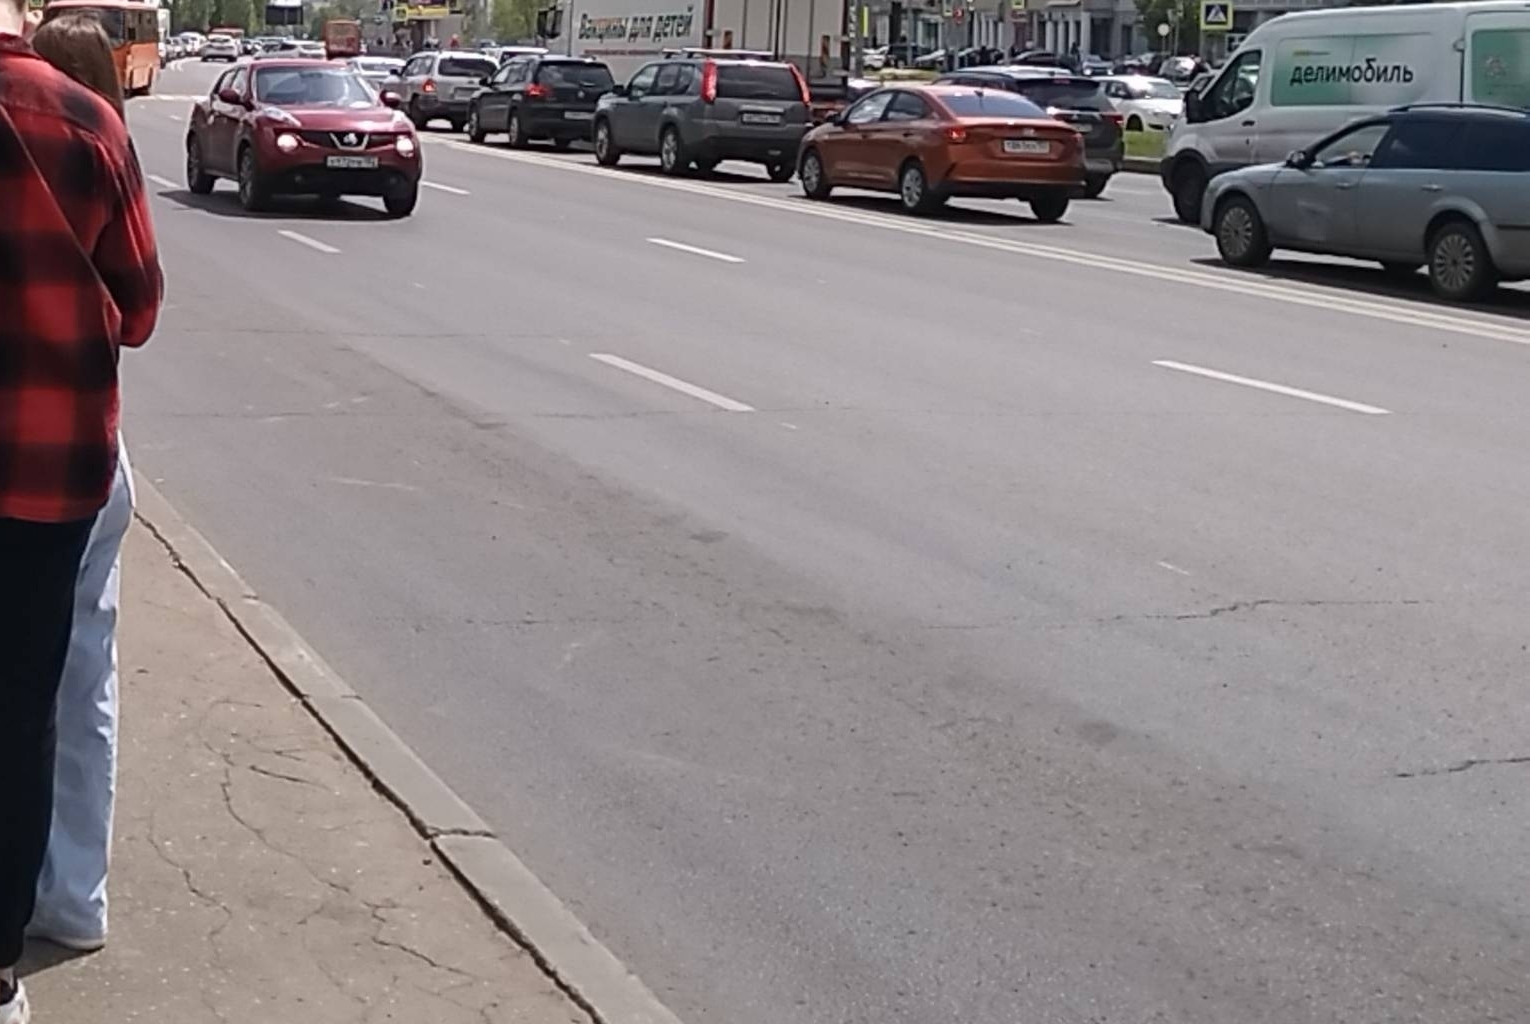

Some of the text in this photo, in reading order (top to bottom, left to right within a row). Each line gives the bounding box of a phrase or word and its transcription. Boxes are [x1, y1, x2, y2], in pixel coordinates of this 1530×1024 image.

[579, 4, 694, 43] Вакцины для детей
[1290, 57, 1414, 86] делимобиль
